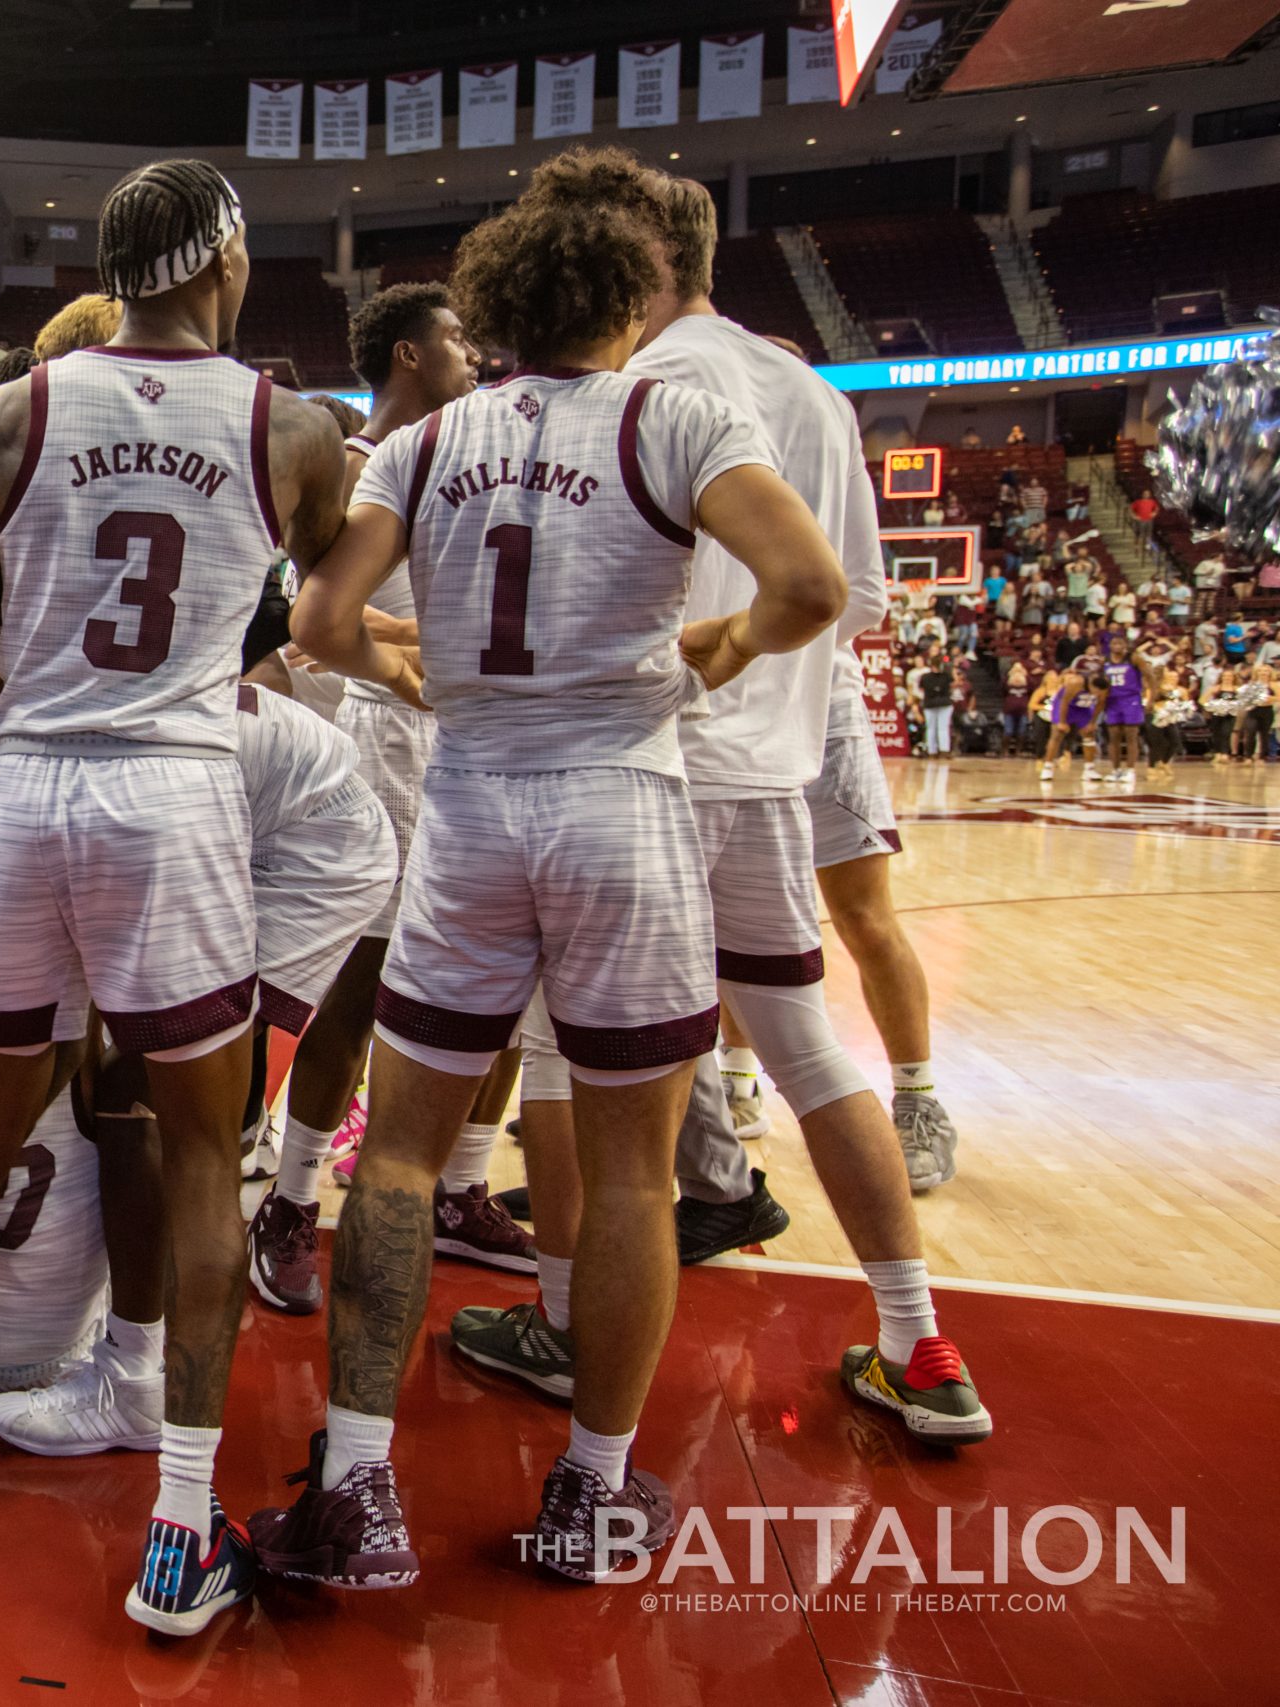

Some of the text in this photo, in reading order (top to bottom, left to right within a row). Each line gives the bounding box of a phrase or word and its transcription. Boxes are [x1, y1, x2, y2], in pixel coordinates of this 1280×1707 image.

[890, 364, 935, 384] YOUR
[943, 359, 1025, 381] PRIMARY
[1034, 351, 1119, 375] PARTNER
[1129, 347, 1166, 368] FOR
[69, 442, 228, 500] JACKSON
[82, 510, 186, 673] 3
[480, 523, 534, 676] 1
